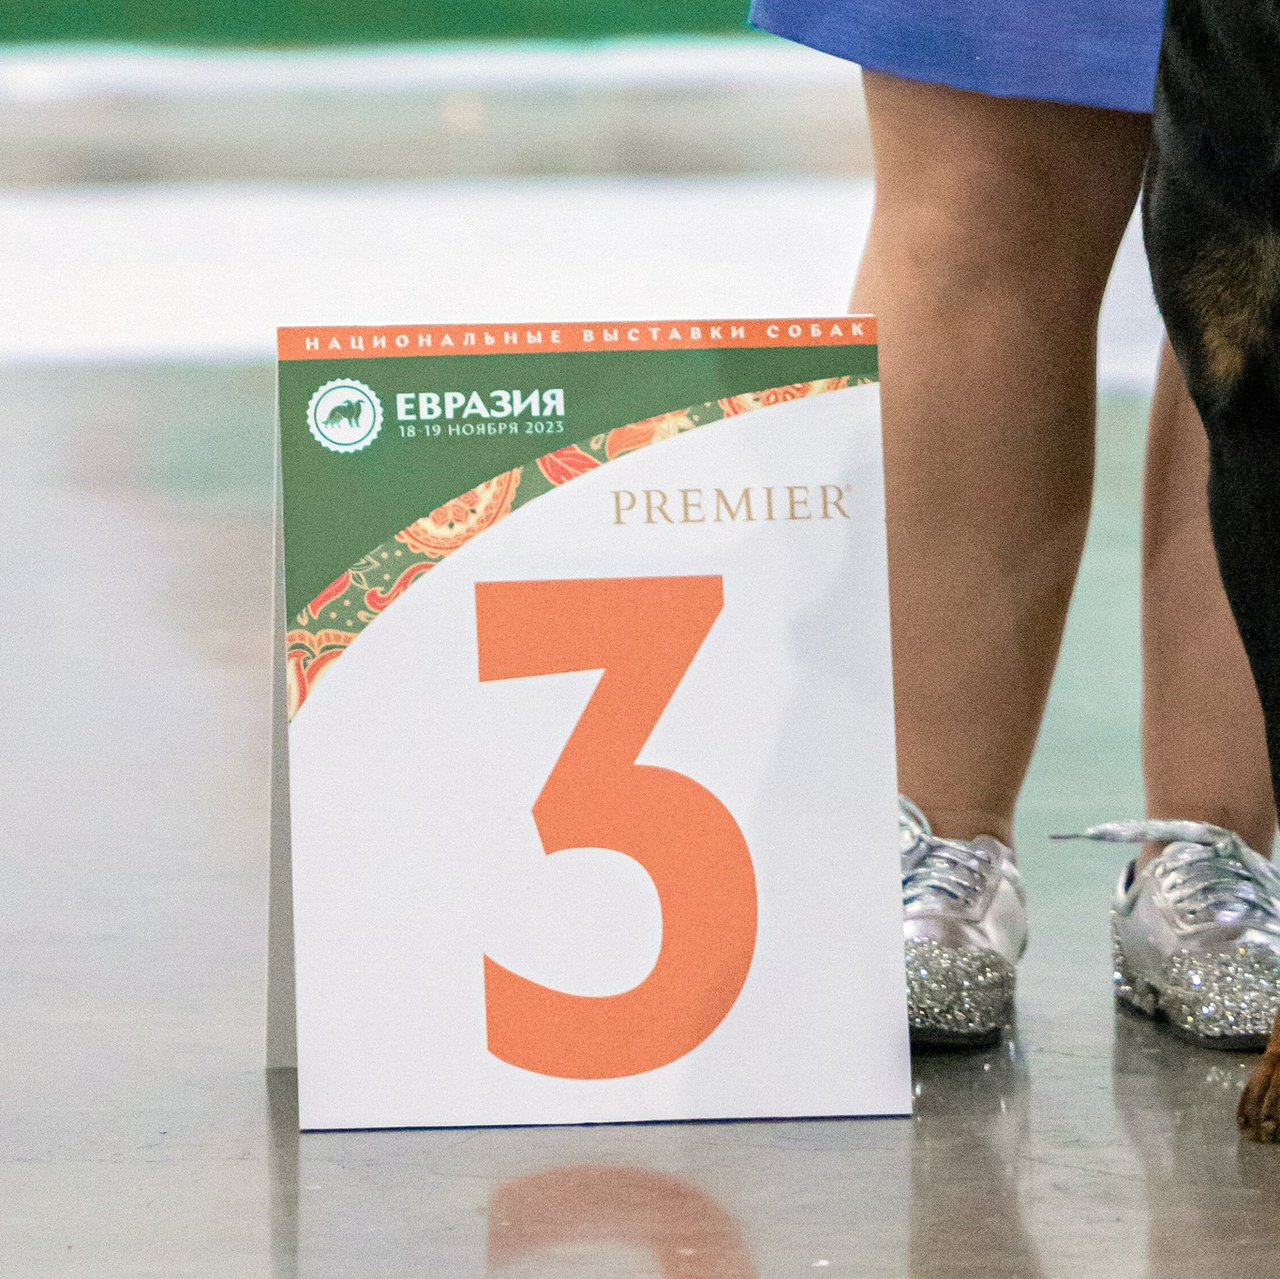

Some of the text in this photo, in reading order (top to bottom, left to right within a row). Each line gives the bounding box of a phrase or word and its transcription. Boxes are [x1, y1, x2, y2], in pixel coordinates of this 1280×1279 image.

[305, 322, 865, 351] НАЦИОНАЛЬНЫЕ ВЫСТАВКИ СОБАК
[396, 388, 566, 421] ЕВРАЗИЯ
[448, 421, 519, 437] НОЯБРЯ
[525, 420, 565, 434] 2023
[474, 574, 758, 1080] 3
